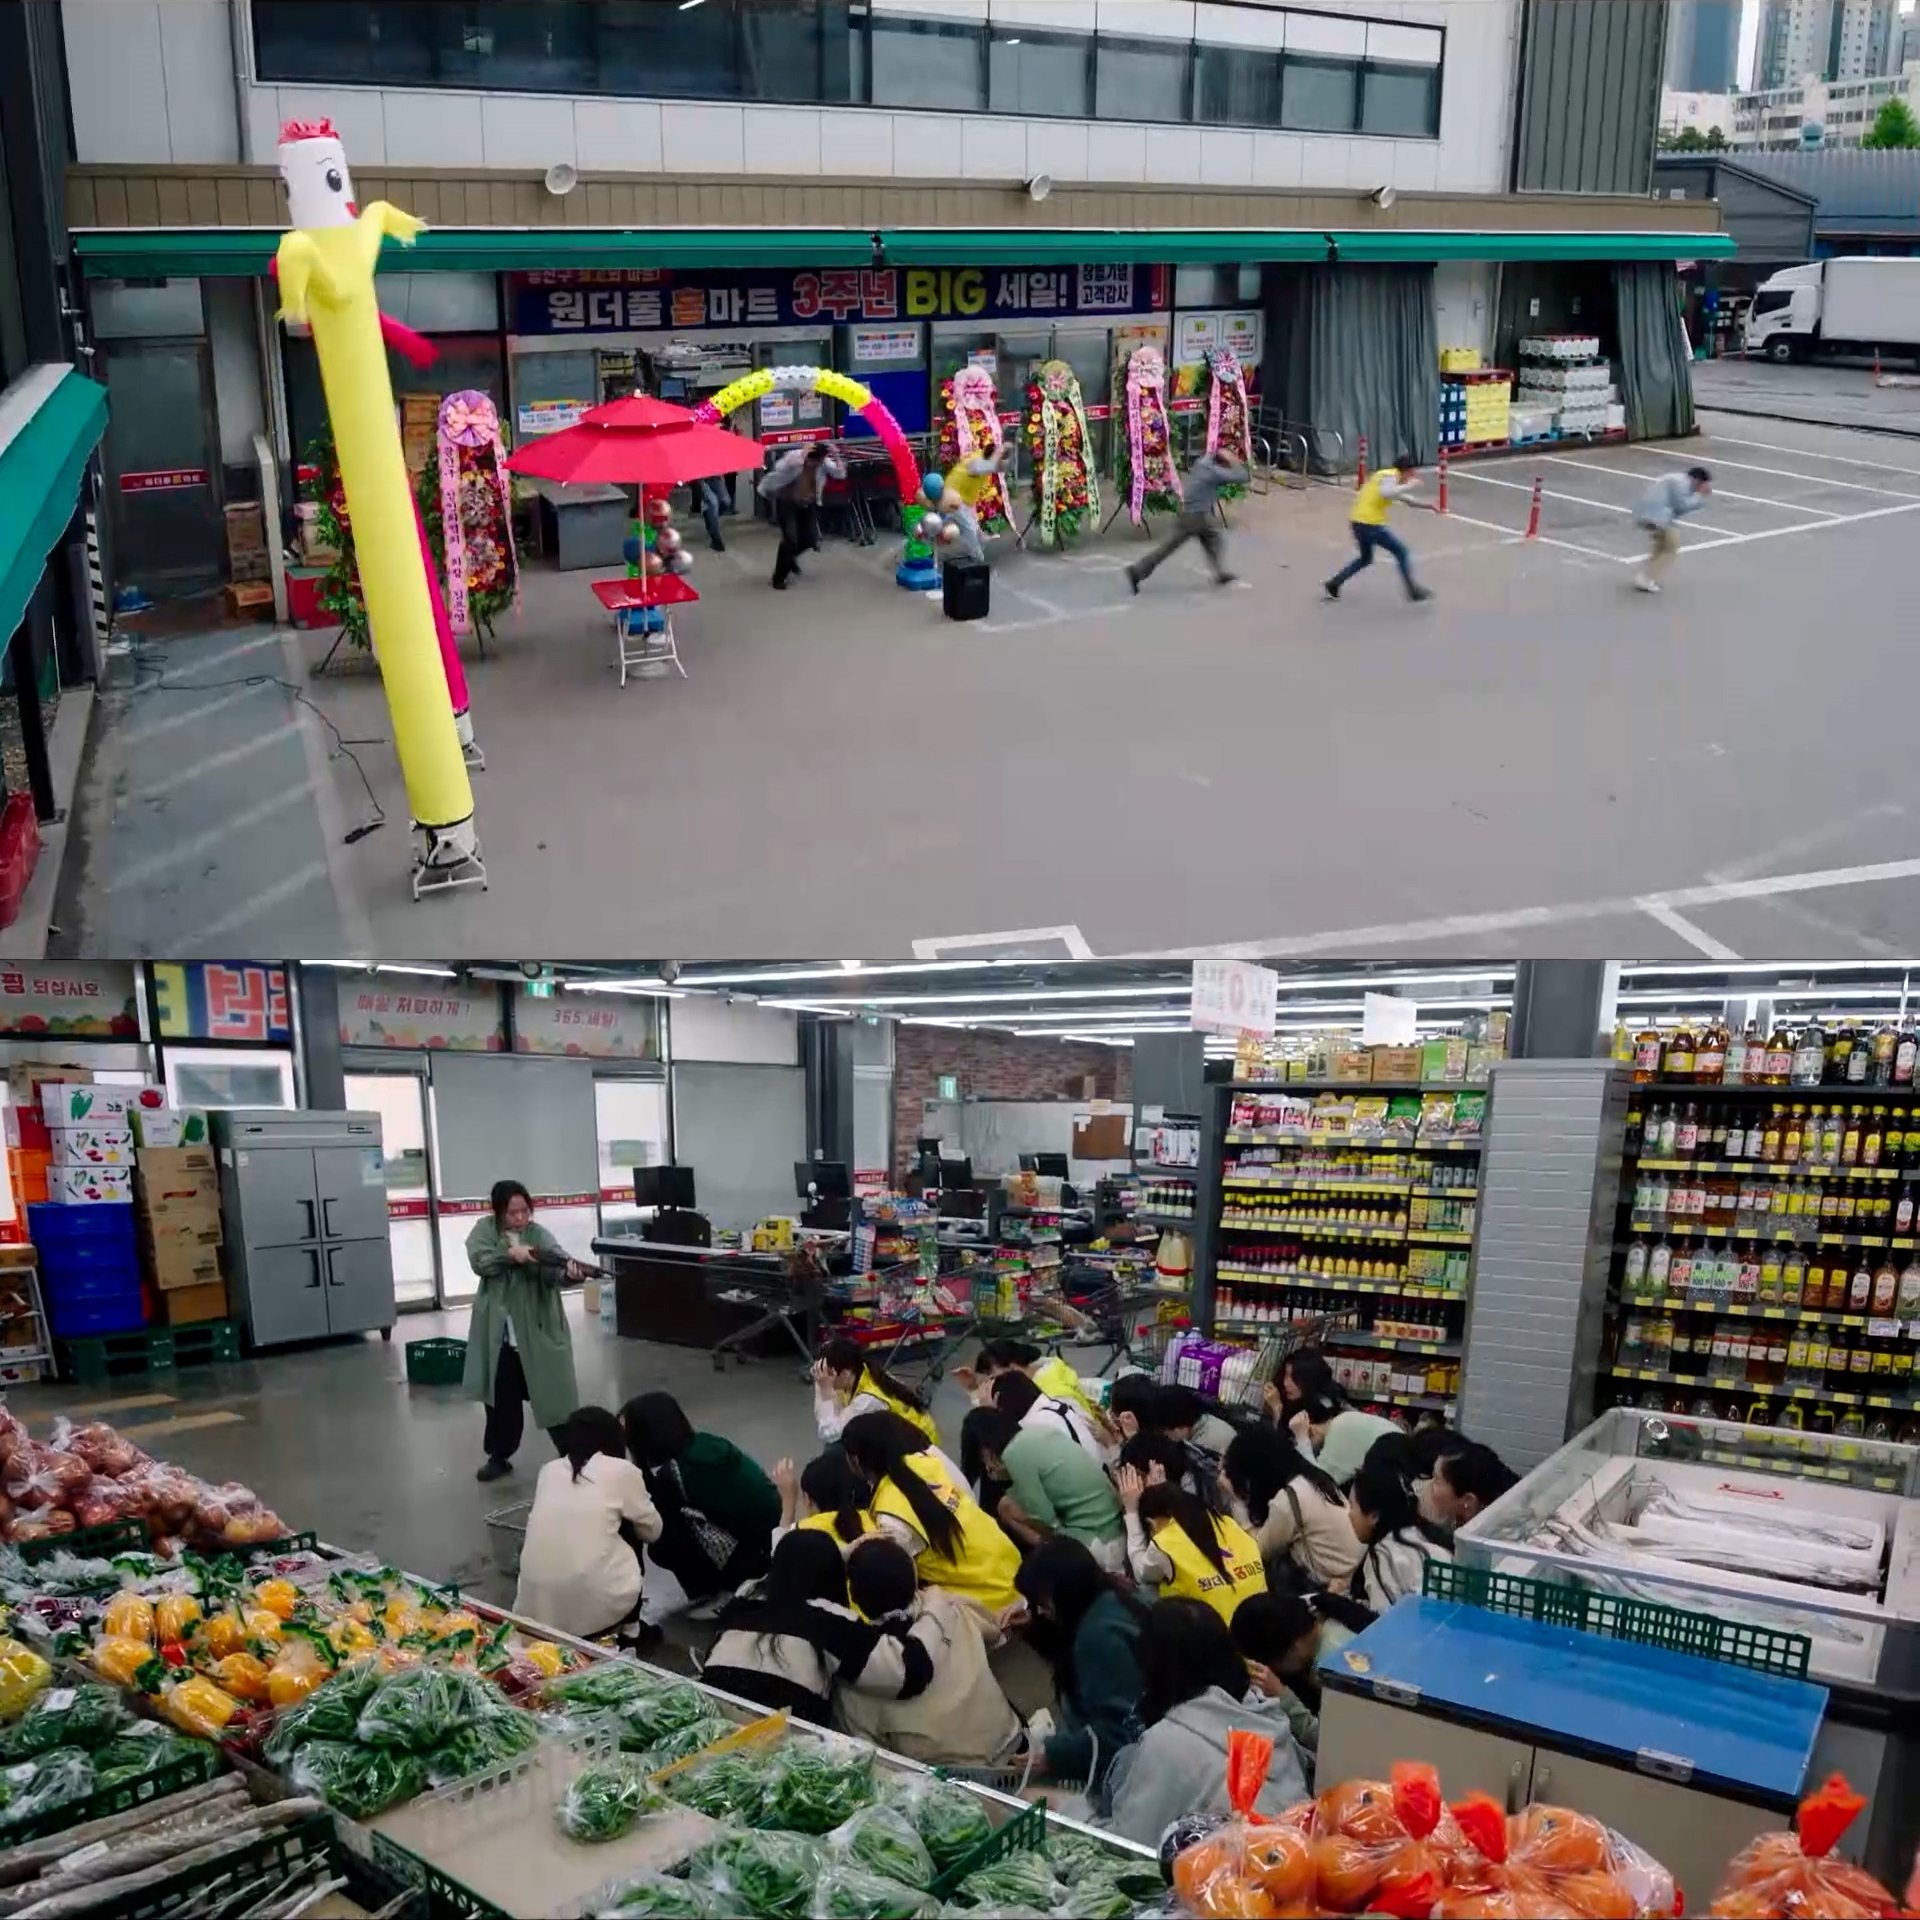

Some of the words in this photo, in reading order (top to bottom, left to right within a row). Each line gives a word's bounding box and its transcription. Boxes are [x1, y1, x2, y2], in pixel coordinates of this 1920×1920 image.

[548, 290, 663, 328] 원더풀
[793, 270, 898, 320] 3주년
[906, 271, 986, 315] BIG
[995, 272, 1068, 309] 세일!
[1082, 285, 1129, 304] 고객감사
